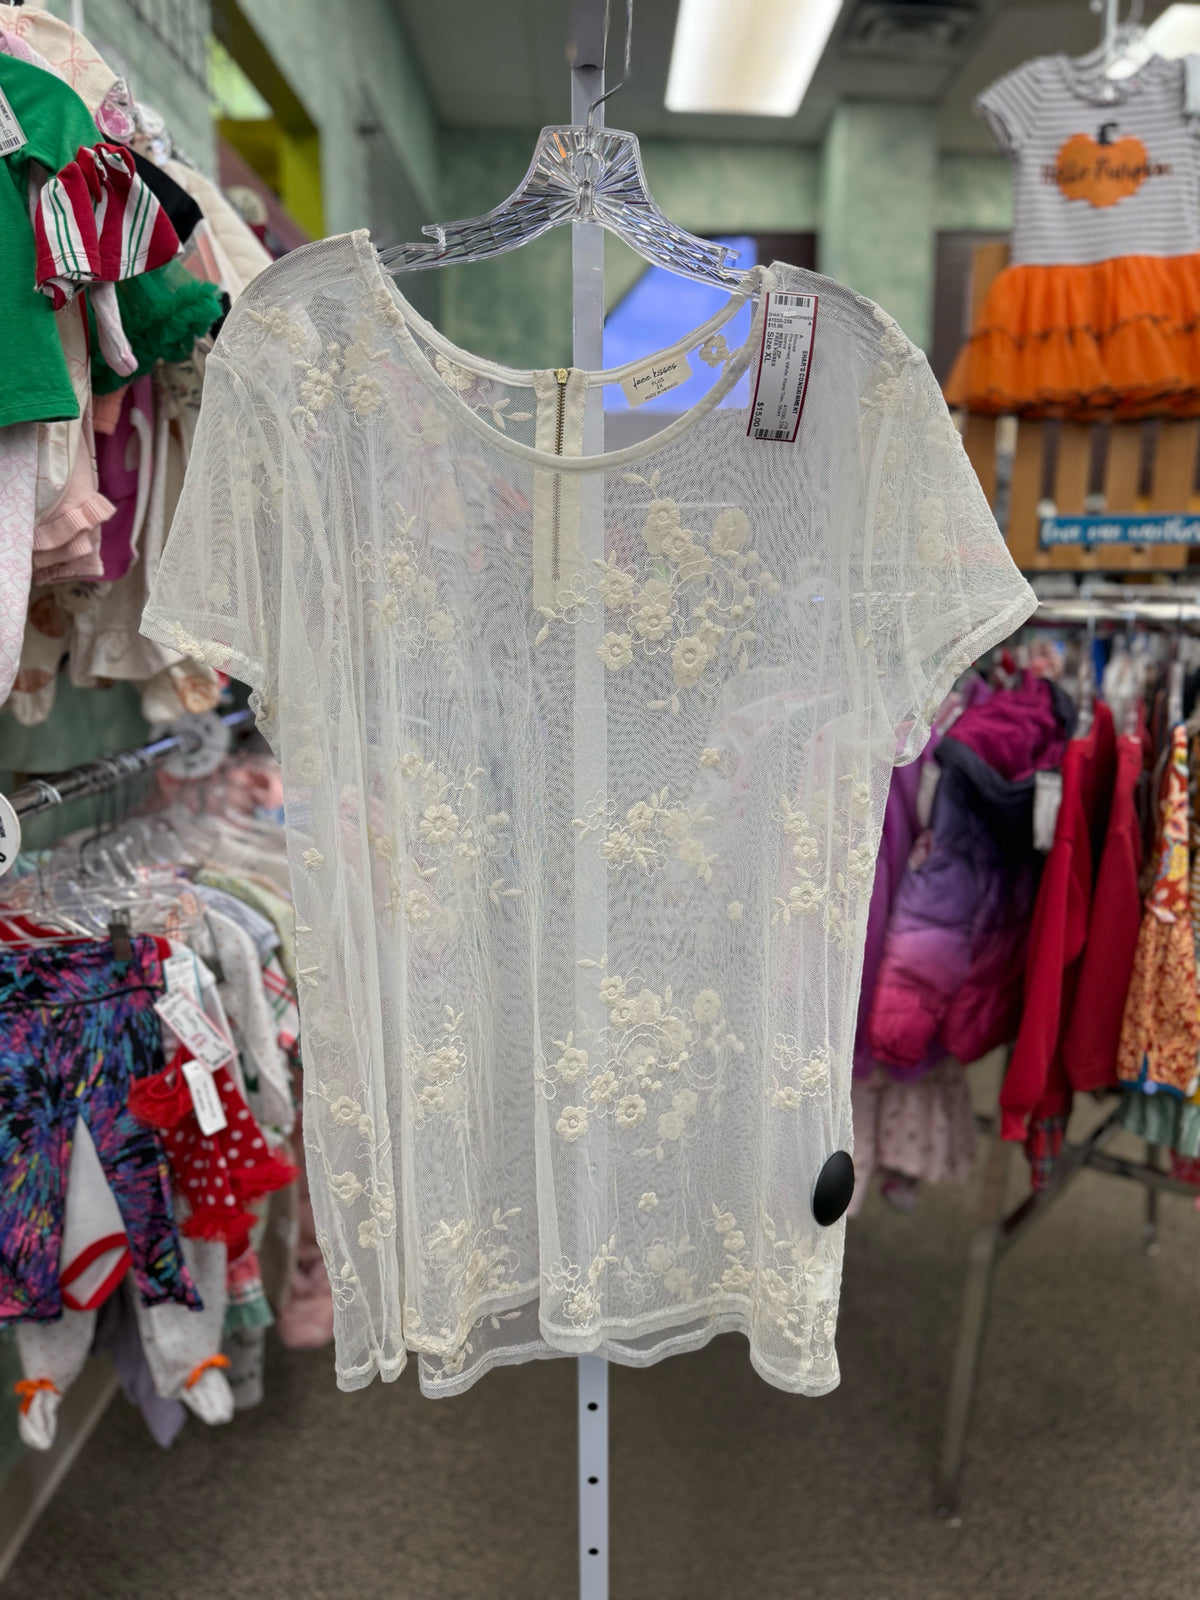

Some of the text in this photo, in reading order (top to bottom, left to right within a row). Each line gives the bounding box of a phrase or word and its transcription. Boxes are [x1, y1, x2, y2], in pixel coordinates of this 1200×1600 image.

[764, 331, 774, 363] Size XL
[651, 362, 678, 378] kisses
[651, 377, 665, 386] PLUS
[661, 381, 679, 393] MEXICO
[792, 350, 808, 414] SHAR'S CONSIGNMENT
[753, 401, 764, 427] $15.00
